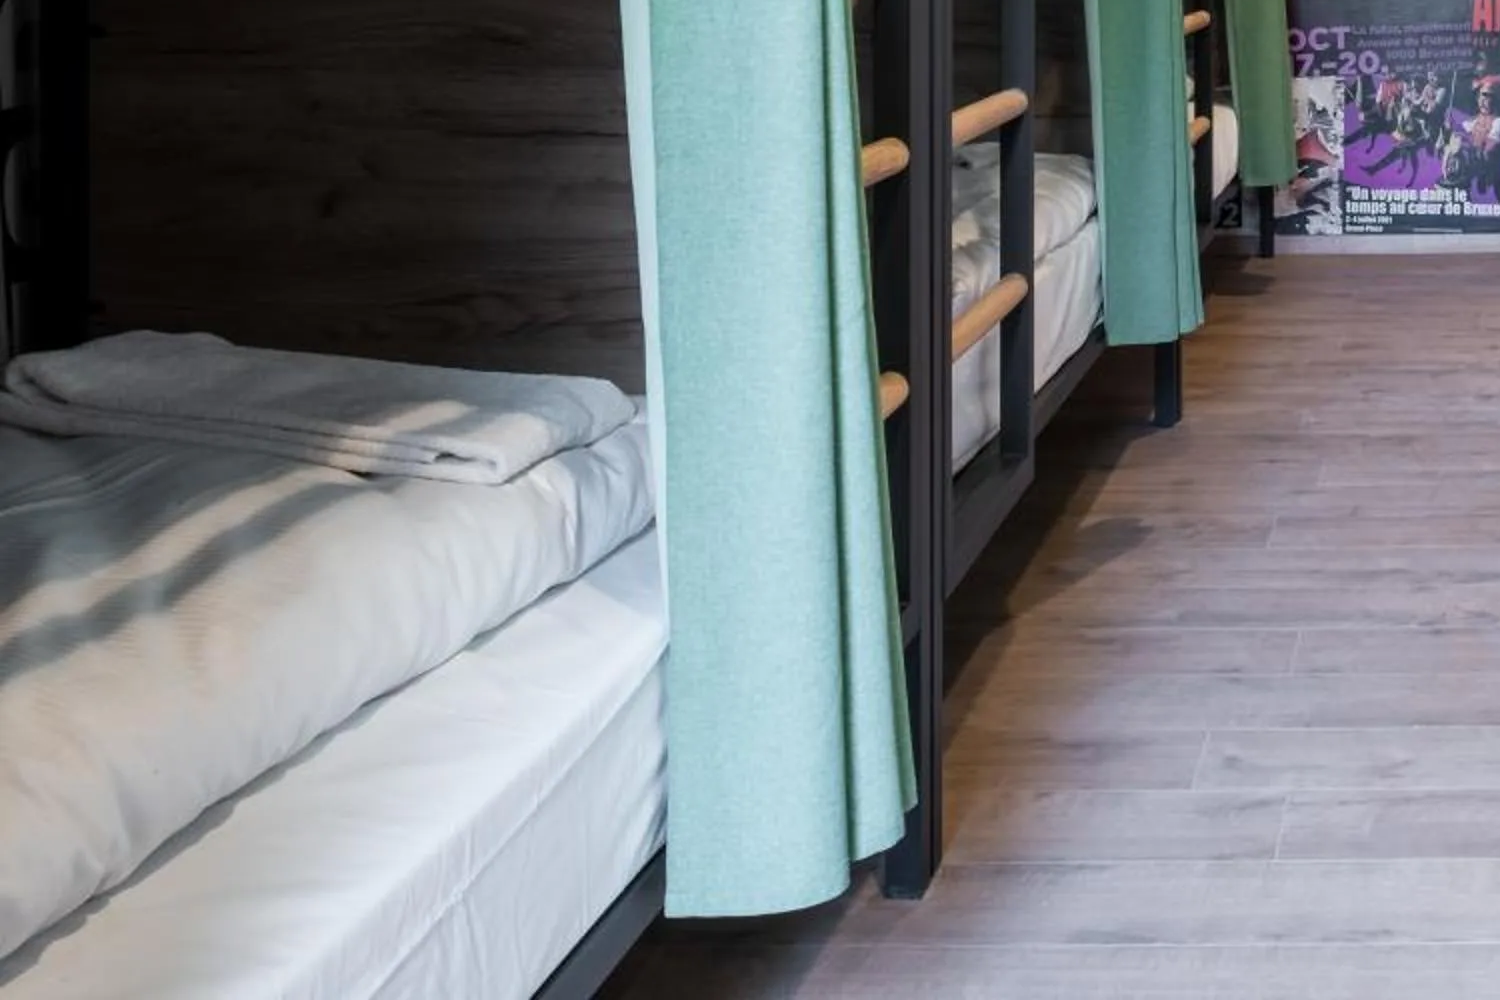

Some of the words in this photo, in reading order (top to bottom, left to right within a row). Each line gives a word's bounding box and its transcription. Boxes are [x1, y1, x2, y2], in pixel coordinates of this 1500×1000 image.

[1294, 50, 1389, 77] 7.-20.
[1371, 186, 1419, 203] voyage
[1453, 187, 1468, 201] le
[1345, 200, 1388, 216] temps
[1389, 200, 1406, 215] au
[1444, 201, 1461, 215] de
